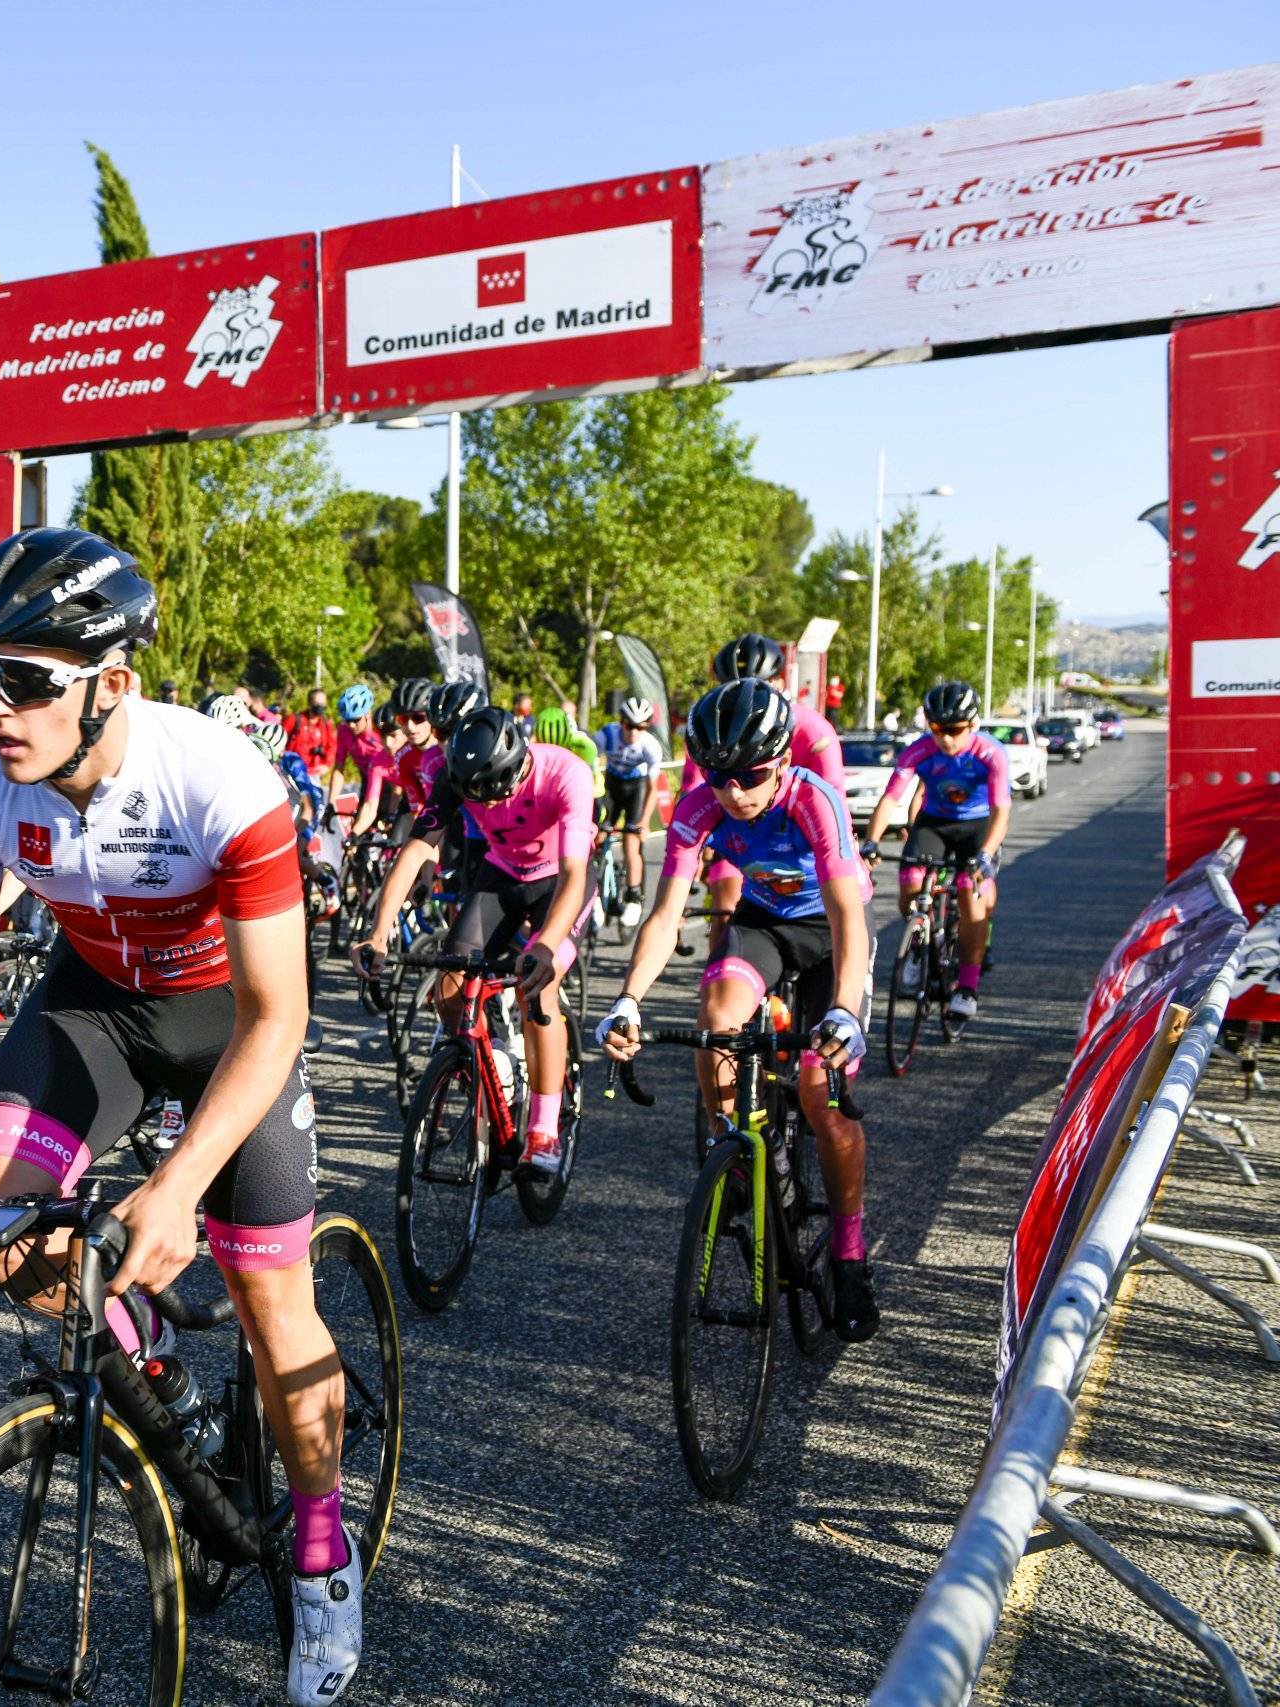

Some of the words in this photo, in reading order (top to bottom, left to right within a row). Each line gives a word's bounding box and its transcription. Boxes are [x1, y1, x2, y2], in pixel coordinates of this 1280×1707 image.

[765, 263, 862, 294] FMC
[28, 305, 166, 344] Federación
[363, 317, 505, 356] Comunidad
[514, 314, 546, 336] de
[555, 298, 652, 331] Madrid
[132, 339, 166, 363] de
[196, 344, 267, 369] FMC
[61, 375, 167, 405] Ciclismo
[119, 827, 148, 839] LIDER
[150, 827, 173, 840] LIGA
[9, 1124, 73, 1163] MAGRO
[219, 1238, 283, 1255] MAGRO
